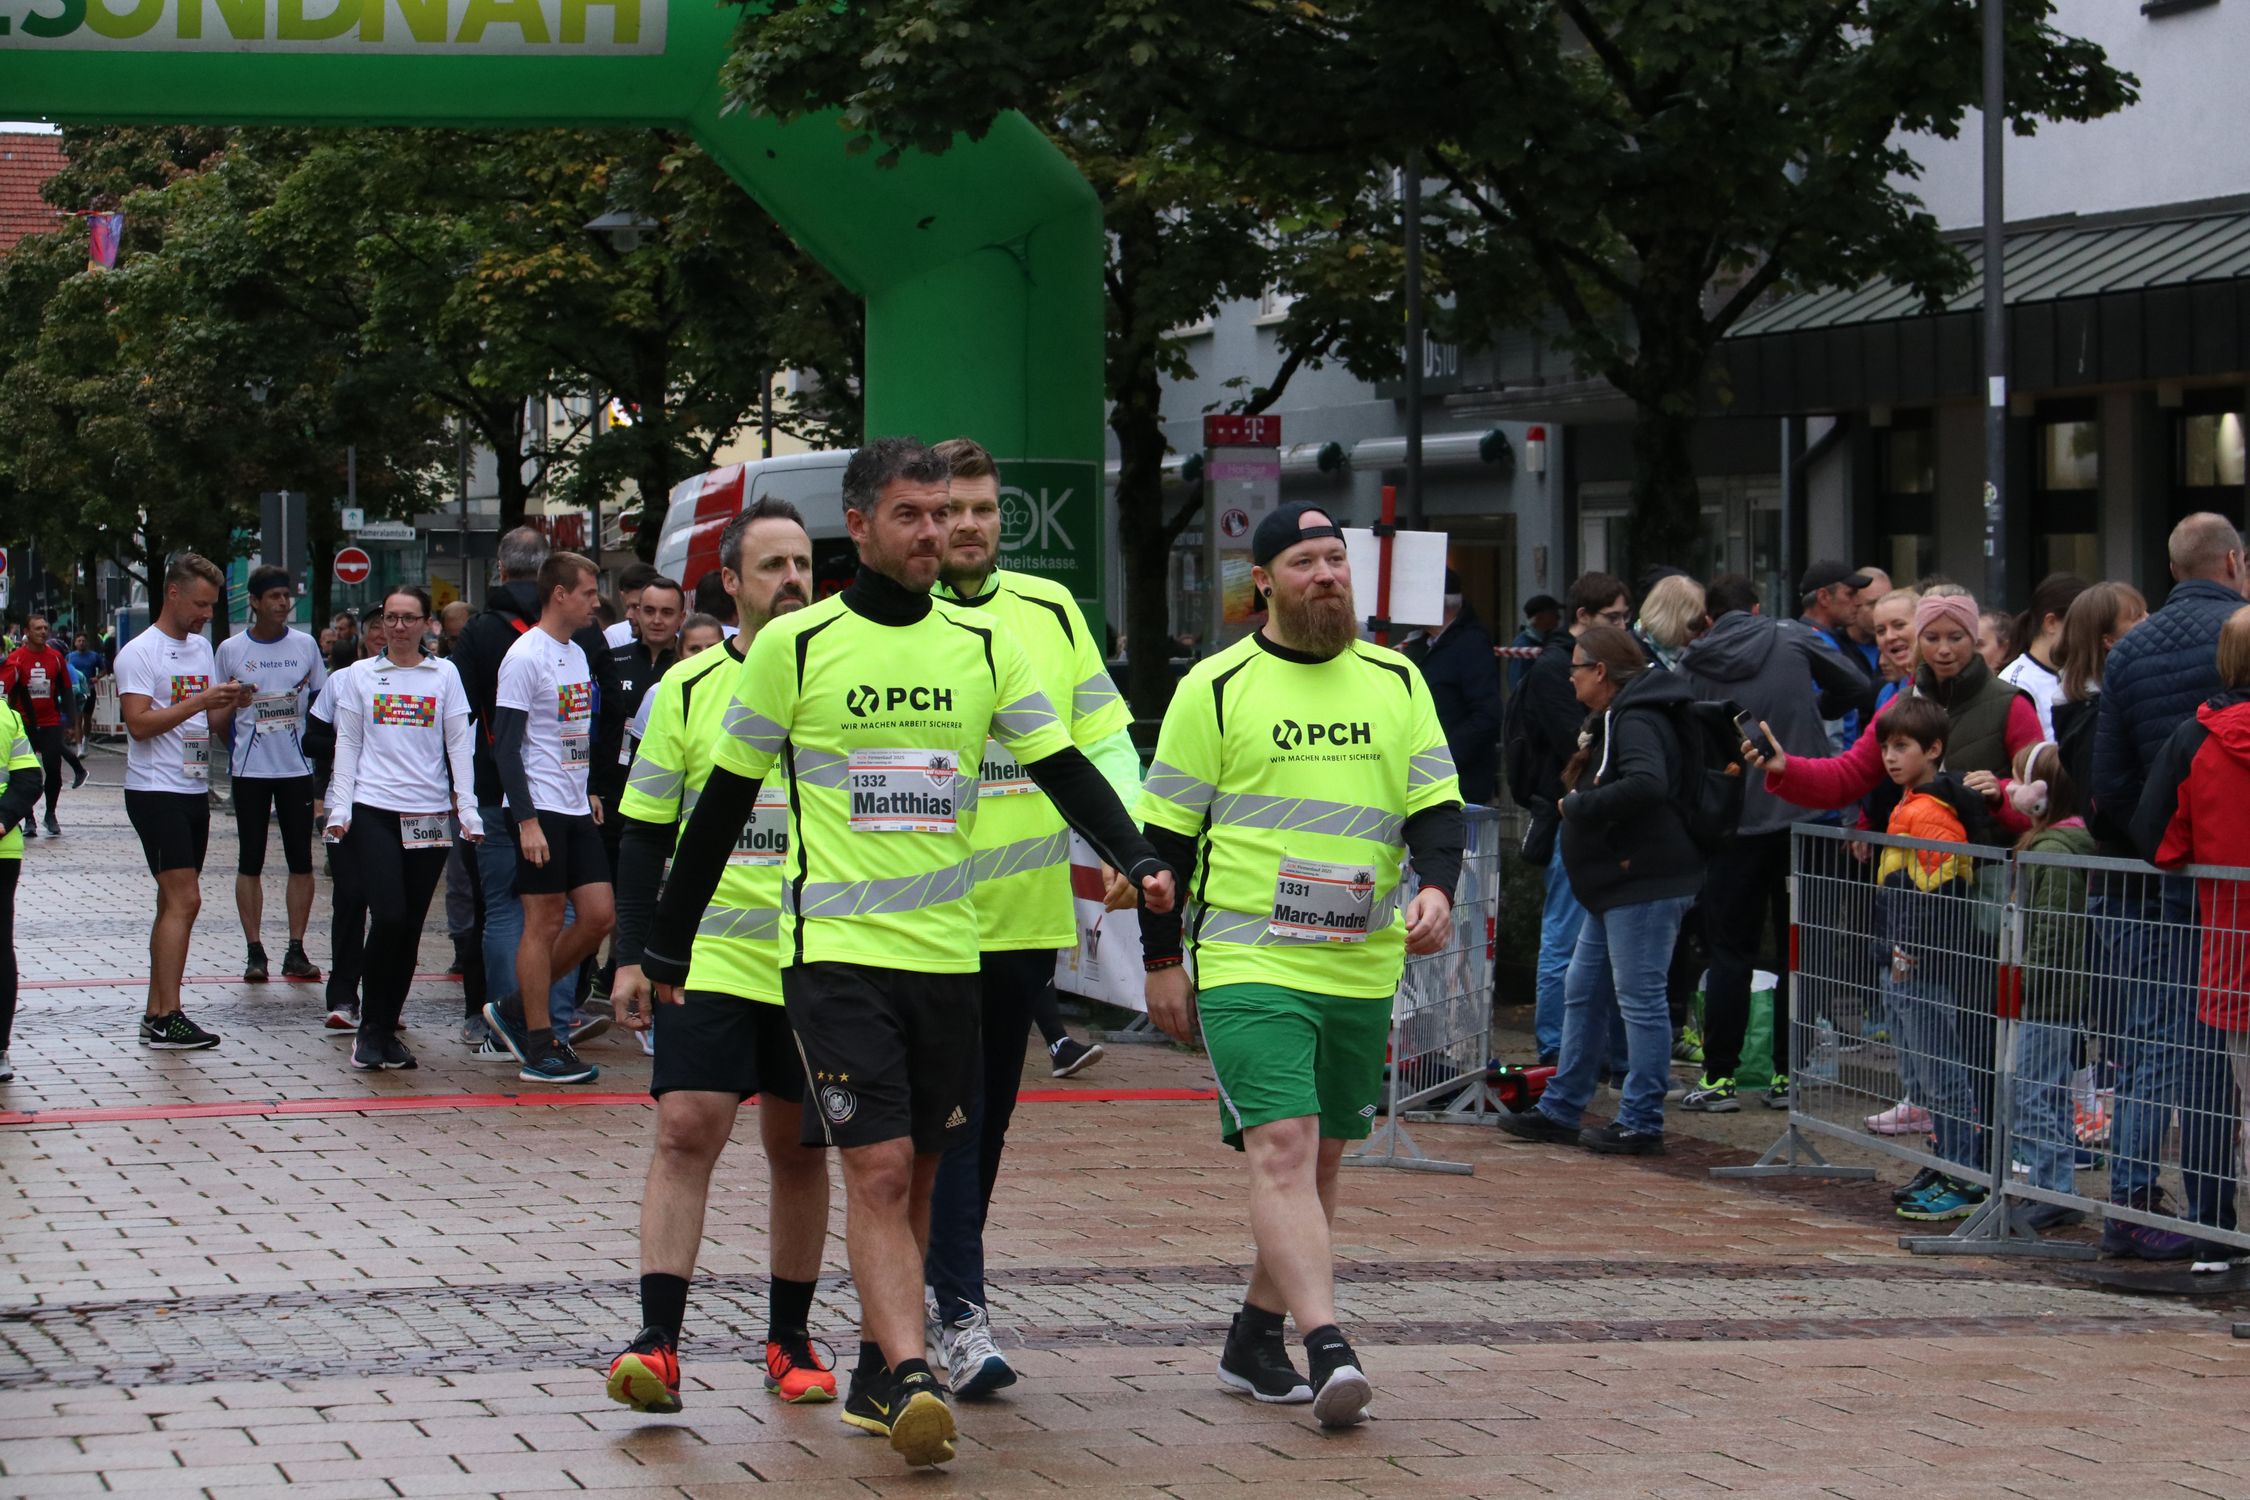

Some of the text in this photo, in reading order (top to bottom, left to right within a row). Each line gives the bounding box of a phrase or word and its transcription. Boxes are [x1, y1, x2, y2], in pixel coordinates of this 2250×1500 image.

[260, 661, 283, 669] Netze
[620, 680, 633, 691] R
[886, 686, 953, 711] PCH
[258, 707, 295, 719] Thomas
[860, 720, 897, 729] MACHEN
[899, 720, 927, 728] ARBEIT
[929, 720, 963, 729] SICHERER
[1307, 722, 1371, 746] PCH
[1270, 755, 1286, 763] WIR
[1288, 754, 1320, 762] MACHEN
[1349, 753, 1381, 761] SICHERER
[852, 774, 887, 787] 1332
[853, 791, 952, 816] Matthias
[403, 819, 419, 827] 1697
[413, 827, 443, 841] Sonja
[1279, 881, 1310, 897] 1331
[945, 1116, 968, 1128] adidas
